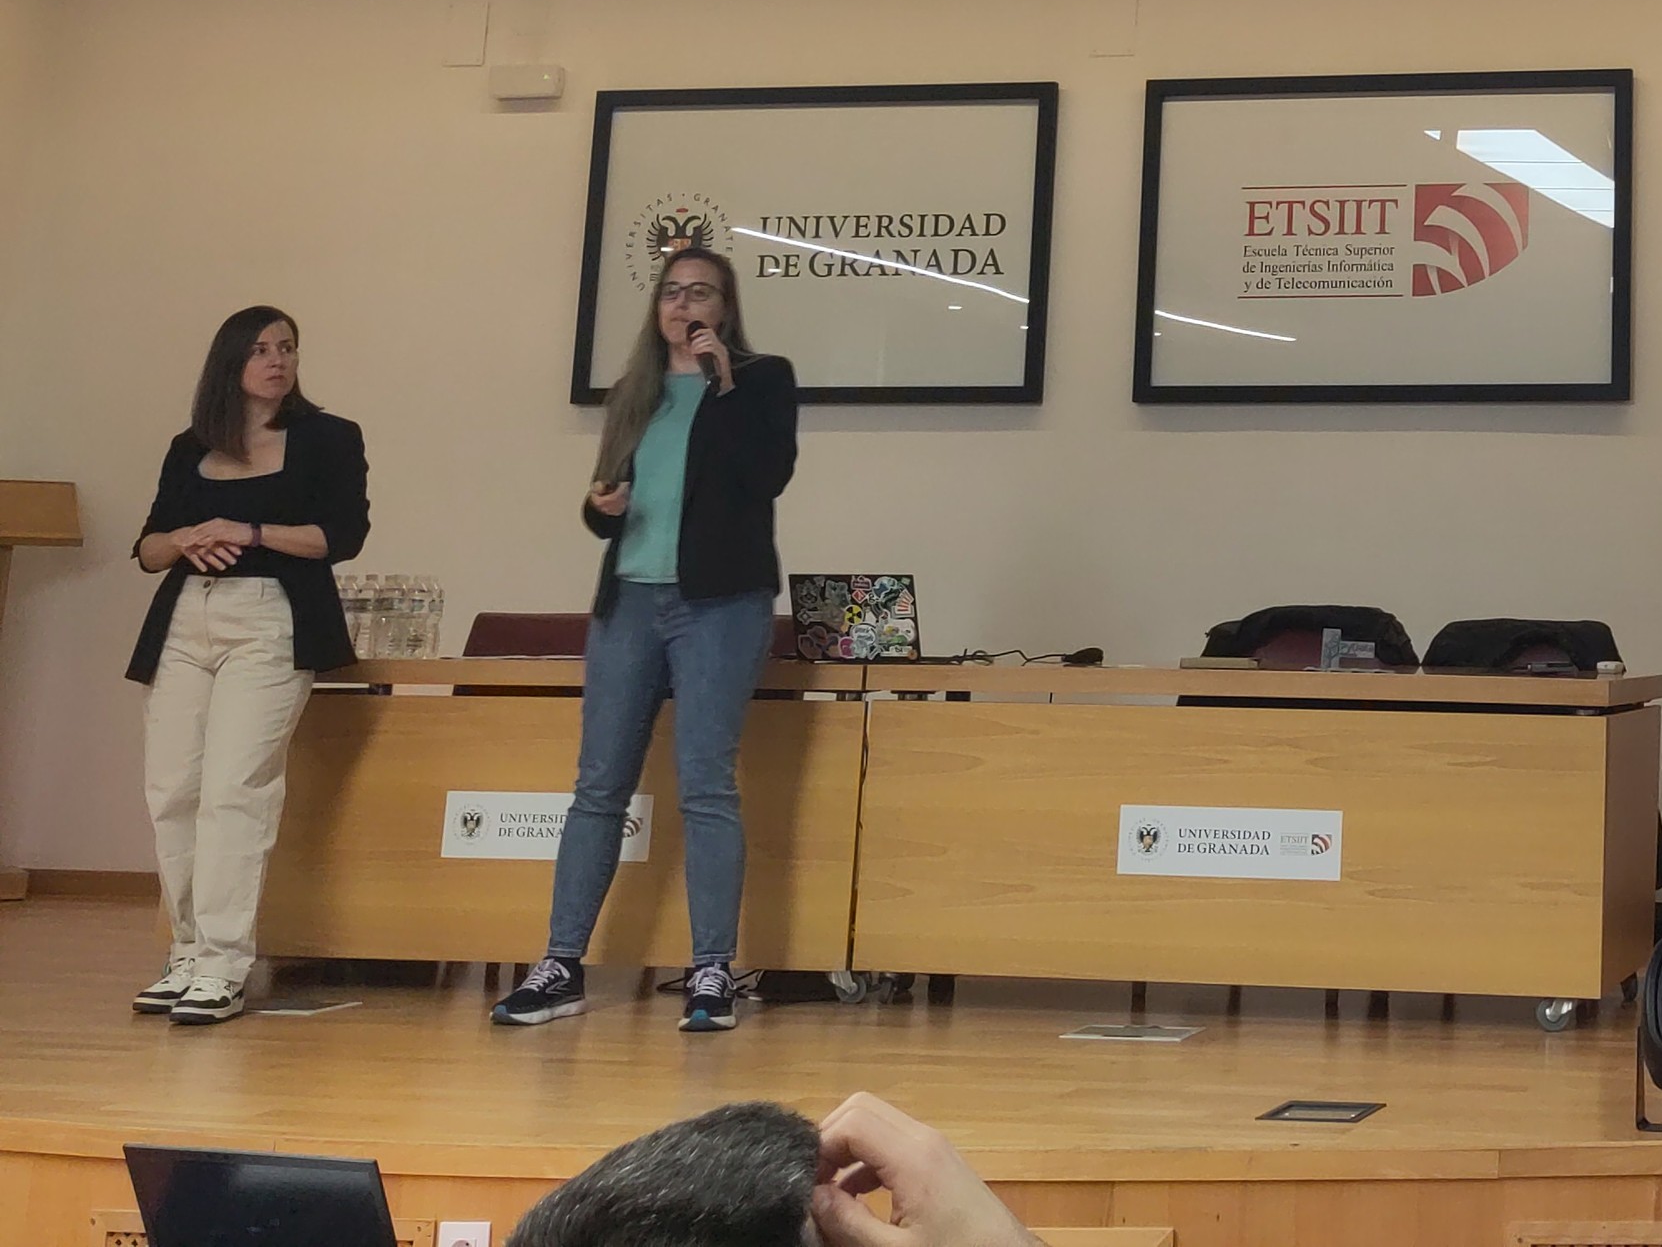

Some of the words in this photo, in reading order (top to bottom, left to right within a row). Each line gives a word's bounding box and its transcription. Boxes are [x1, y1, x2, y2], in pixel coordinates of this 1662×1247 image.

[759, 212, 1007, 240] UNIVERSIDAD
[1244, 199, 1399, 237] ETSIIT
[1243, 244, 1288, 258] Escuela
[1293, 243, 1339, 257] Técnica
[1344, 242, 1395, 259] Superior
[756, 254, 801, 278] DE
[808, 248, 1005, 278] GRANADA
[1242, 261, 1257, 274] de
[1259, 260, 1324, 276] Ingenierías
[1327, 259, 1395, 273] Informática
[1243, 279, 1252, 293] y
[1256, 277, 1272, 290] de
[1275, 276, 1393, 290] Telecomunicación
[500, 812, 567, 824] UNIVERSI
[516, 826, 563, 839] GRANA
[1178, 828, 1272, 841] UNIVERSIDAD
[1177, 843, 1195, 854] DE
[1196, 842, 1271, 856] GRANADA
